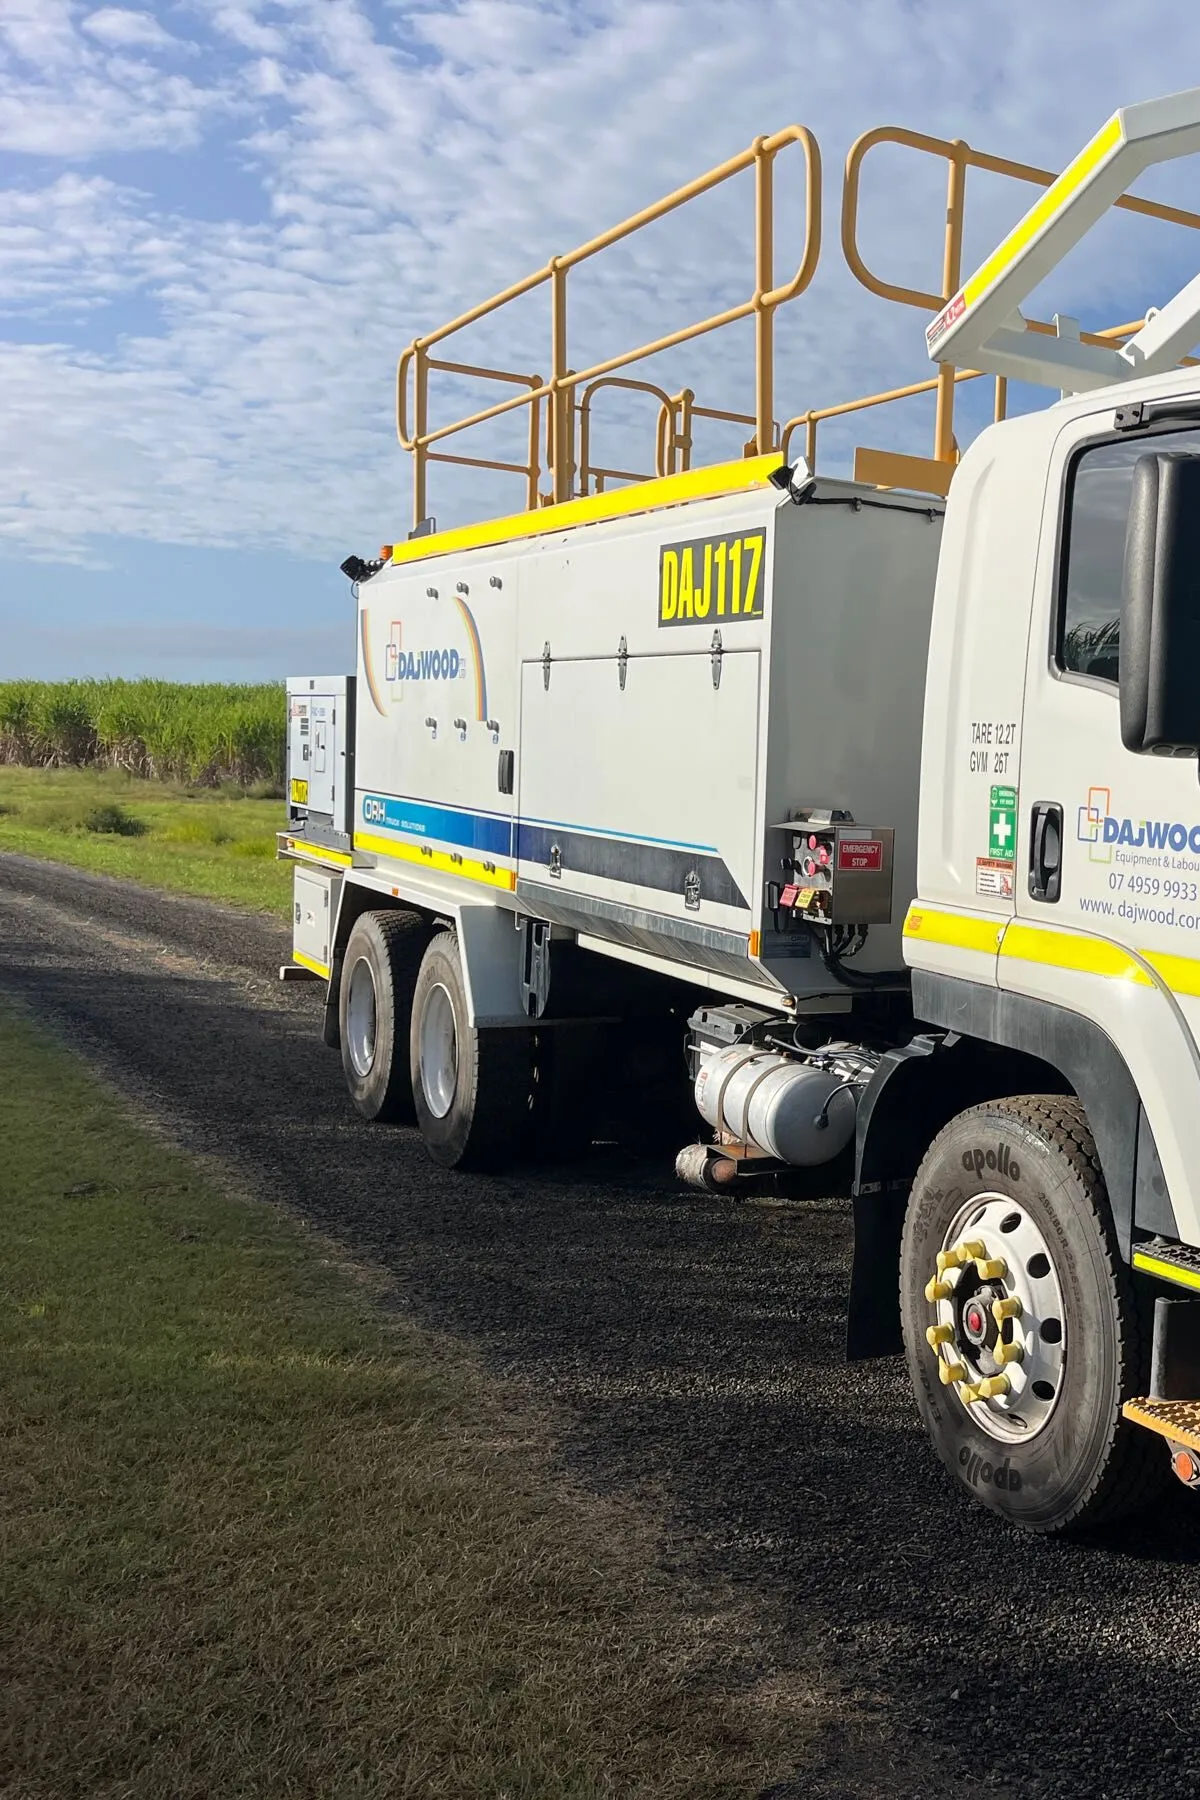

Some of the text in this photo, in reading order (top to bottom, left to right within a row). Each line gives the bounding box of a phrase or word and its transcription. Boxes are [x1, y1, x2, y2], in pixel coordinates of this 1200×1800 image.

[662, 535, 763, 620] DAJ117
[972, 722, 1016, 744] TARE 12.2T
[970, 751, 1009, 773] GVM 26T
[842, 845, 878, 854] EMERGENCY
[989, 847, 1014, 858] FIRST AID
[1115, 850, 1162, 868] Equipment
[1163, 856, 1169, 868] &
[852, 858, 868, 867] STOP
[1109, 872, 1197, 901] 07 4959 9933
[1079, 897, 1115, 915] www.
[962, 1142, 1020, 1182] apollo
[958, 1446, 1023, 1492] apollo
